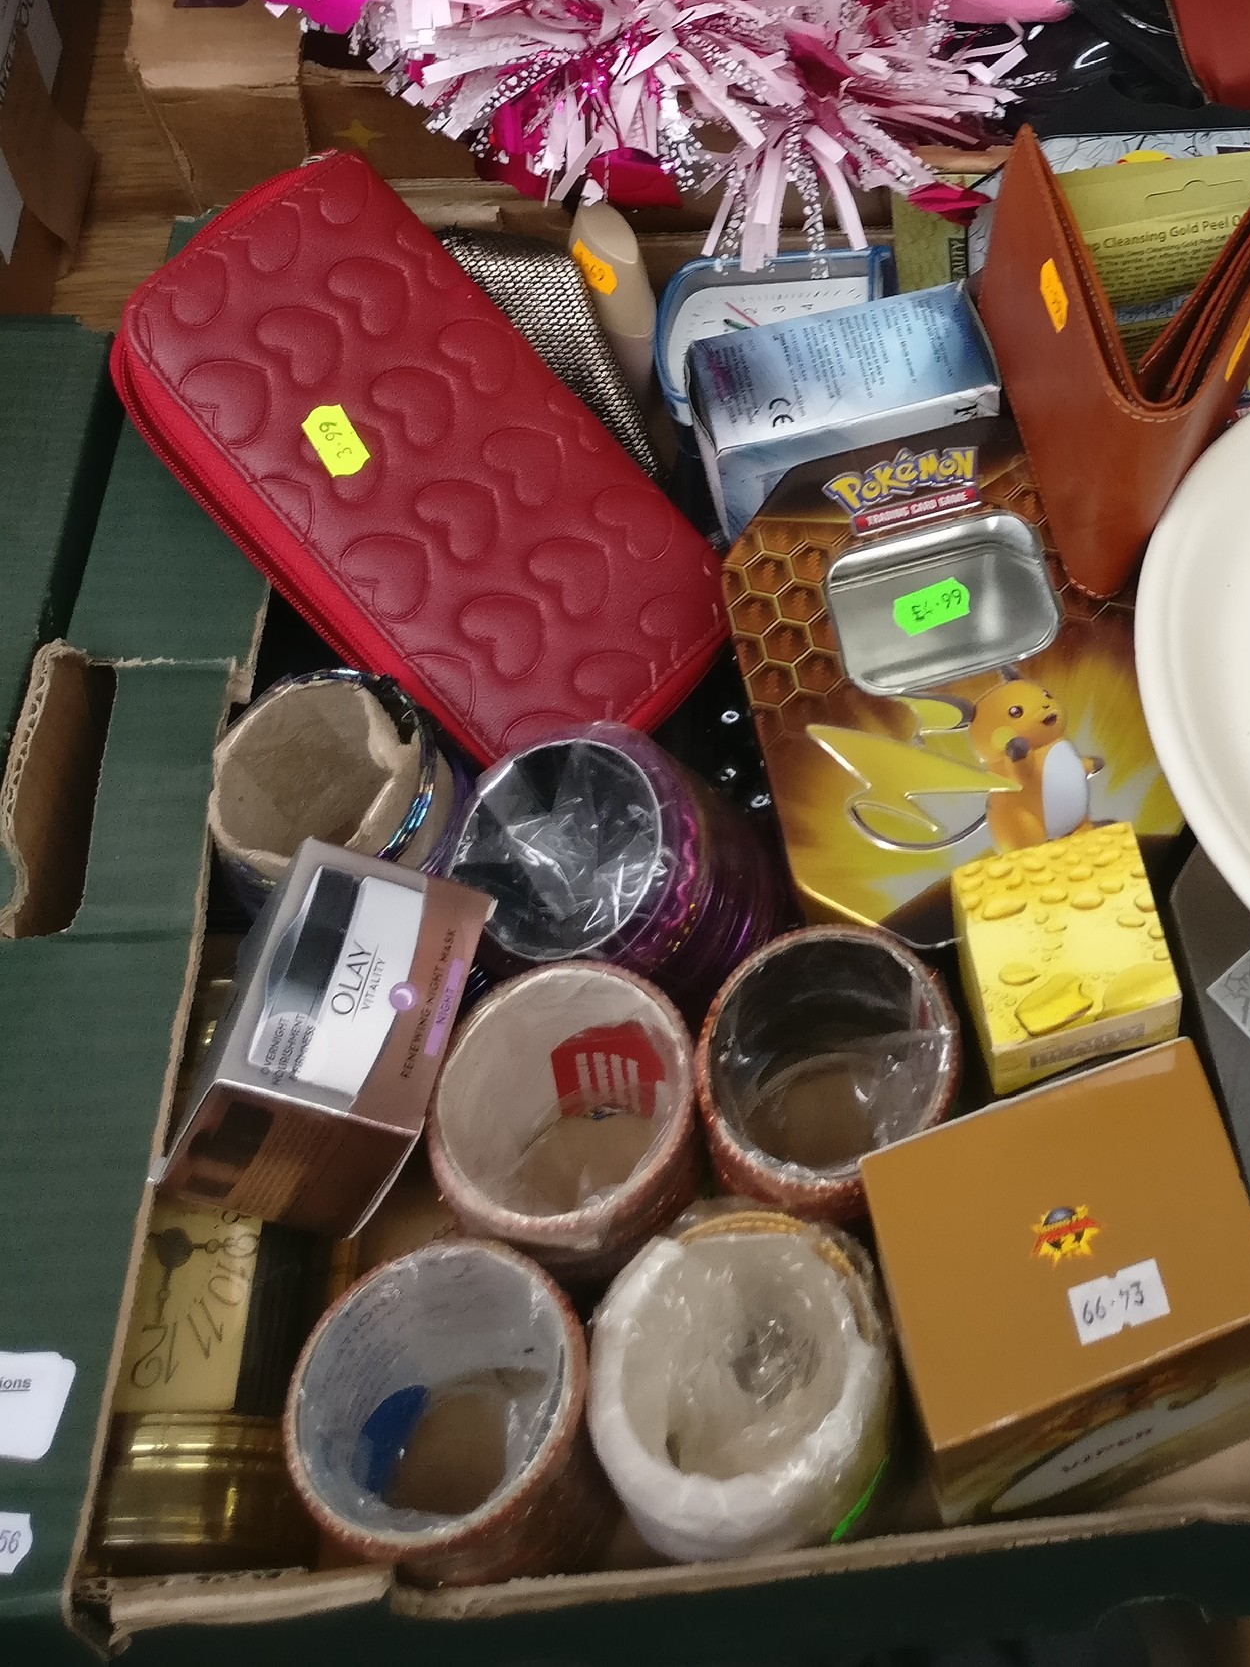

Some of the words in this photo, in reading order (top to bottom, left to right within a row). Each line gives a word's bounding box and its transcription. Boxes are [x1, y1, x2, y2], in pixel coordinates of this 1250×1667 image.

[1103, 227, 1167, 249] Cleansing
[1170, 219, 1199, 237] Gold
[1202, 216, 1229, 230] Peel
[866, 507, 910, 527] TRADING
[910, 498, 937, 514] CARD
[938, 491, 968, 508] GAME
[331, 939, 372, 1014] OLAY
[362, 958, 386, 1010] VITALITY
[401, 1008, 432, 1079] RENEWING
[427, 964, 443, 1006] NIGHT
[441, 930, 457, 962] MASK
[436, 988, 456, 1025] NIGHT
[261, 1017, 289, 1074] OVERNIGHT
[272, 1014, 306, 1085] NOURISHMENT
